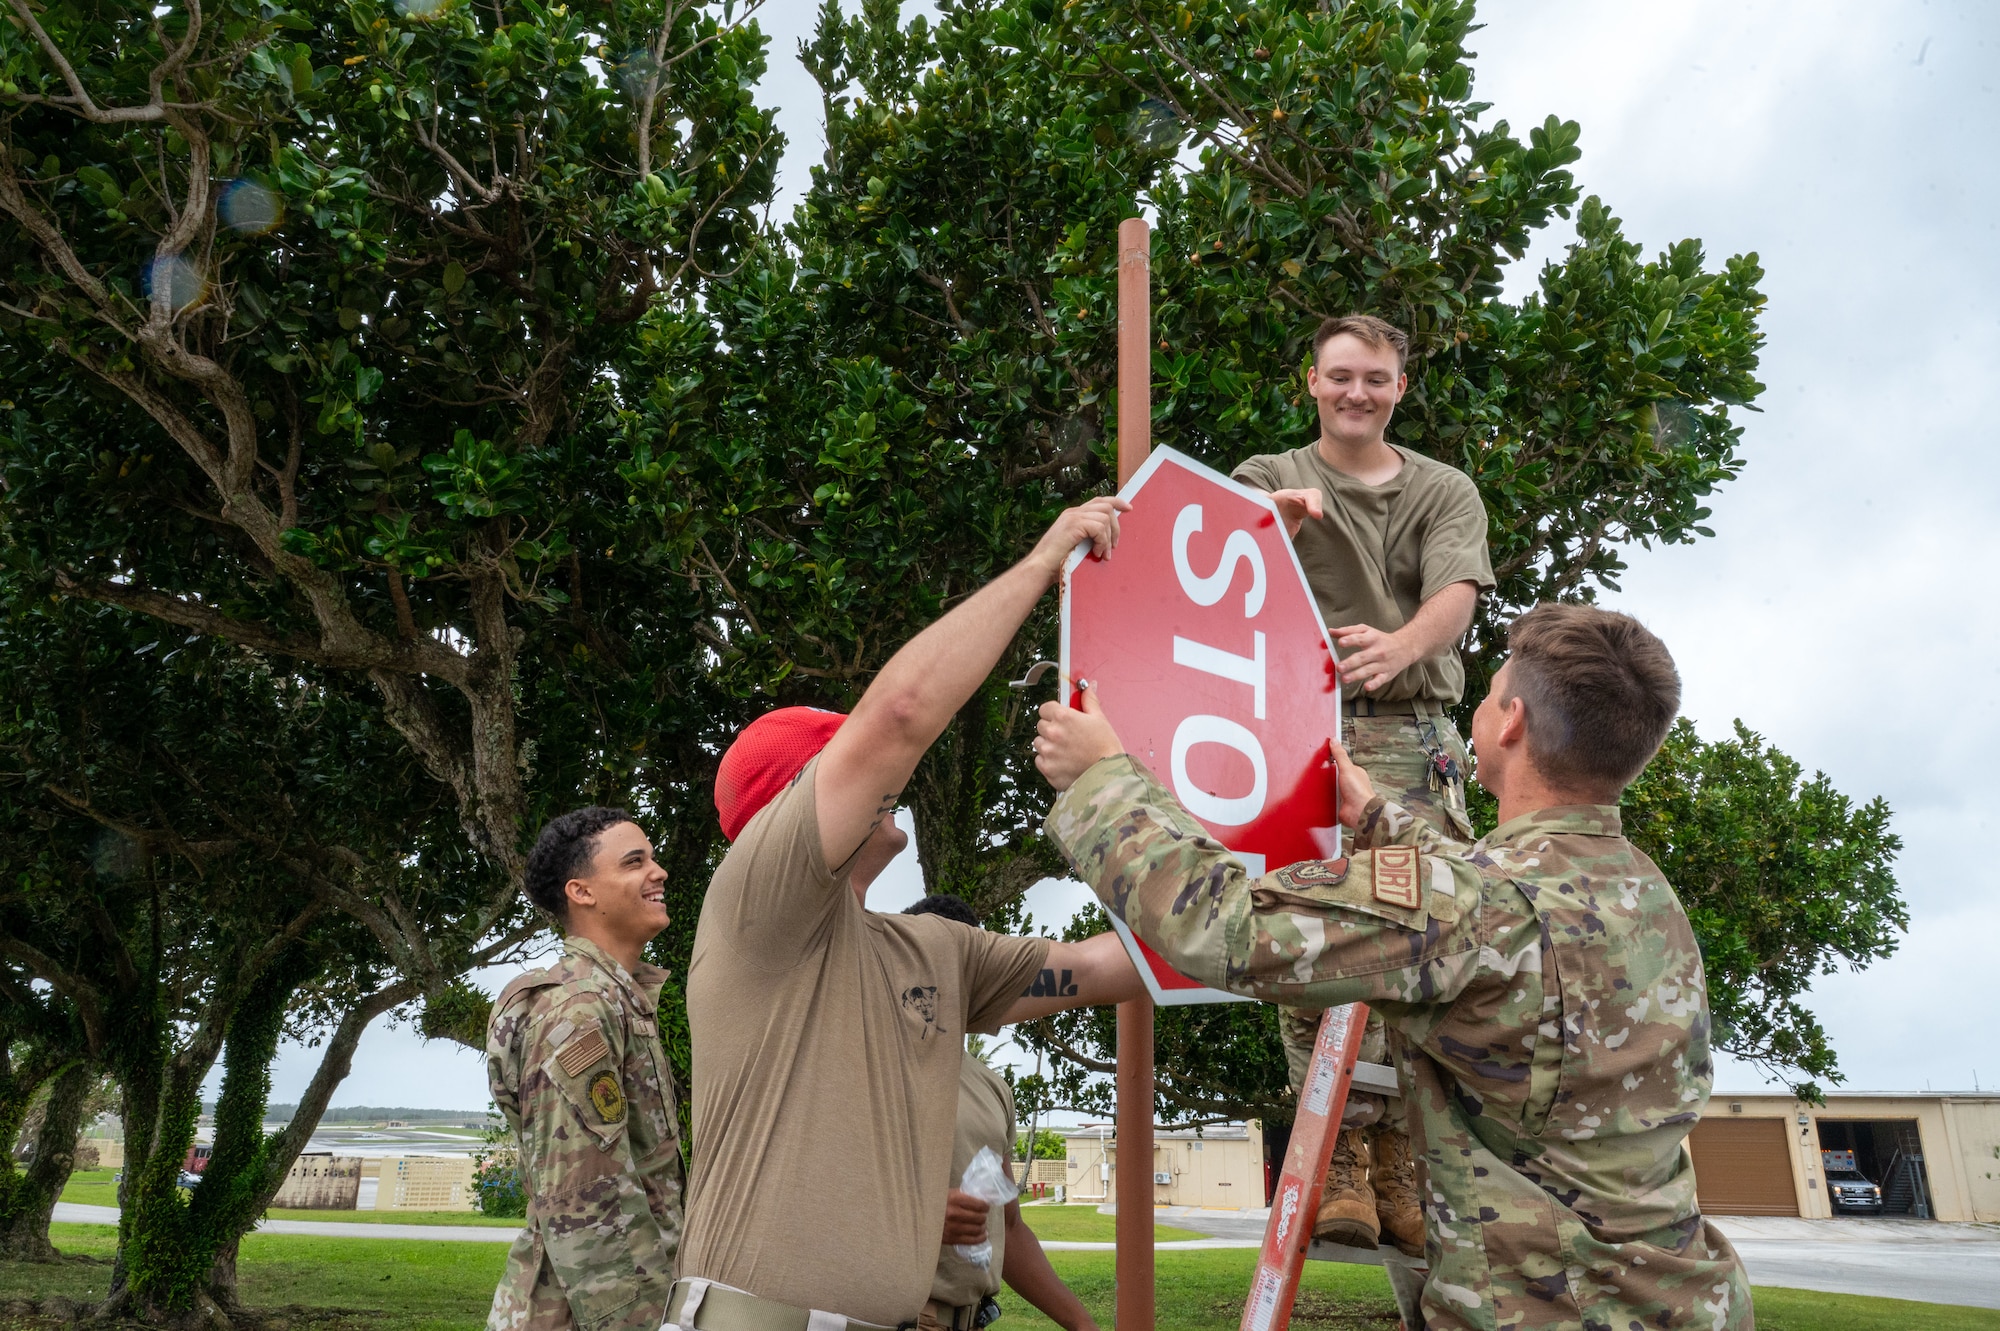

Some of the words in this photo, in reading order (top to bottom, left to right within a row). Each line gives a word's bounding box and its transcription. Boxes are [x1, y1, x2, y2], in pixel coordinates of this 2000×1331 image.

[1171, 503, 1267, 880] STO
[1379, 852, 1412, 902] DIRT
[1020, 968, 1078, 997] AL
